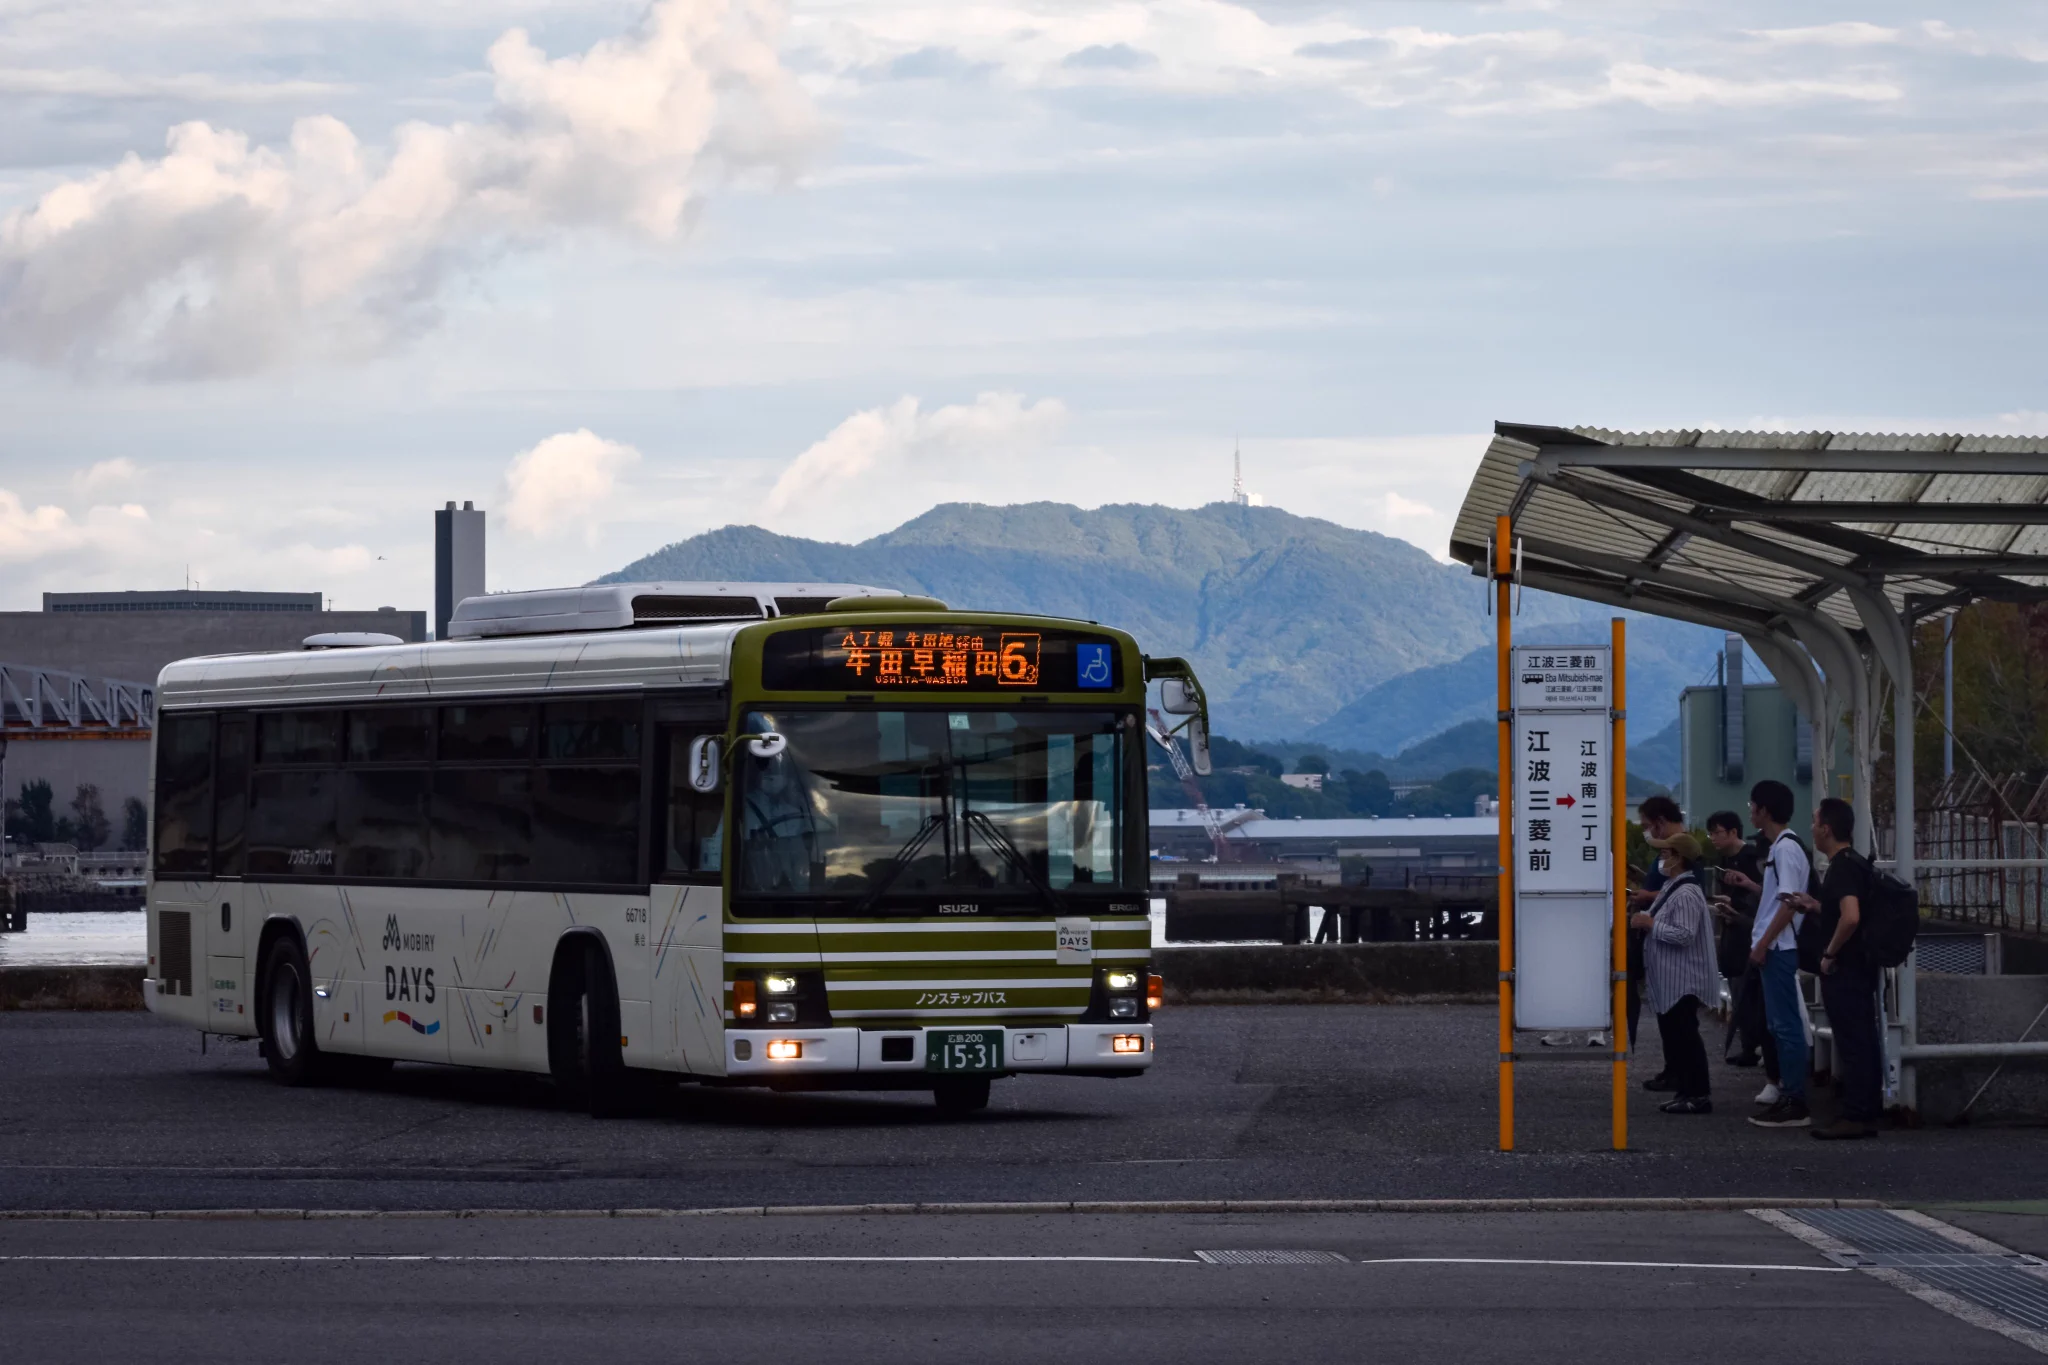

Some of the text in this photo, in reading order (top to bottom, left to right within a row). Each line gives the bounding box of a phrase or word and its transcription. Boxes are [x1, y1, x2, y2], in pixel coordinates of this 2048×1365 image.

[841, 631, 893, 647] 八丁堀
[846, 649, 997, 676] 牛田早稲田
[1002, 641, 1027, 679] 6
[1528, 656, 1596, 668] 江波三菱前
[875, 675, 968, 684] USHITA-WASEDA
[1545, 673, 1603, 682] Eba Mitsubishi-mae
[1527, 730, 1551, 871] 江波三菱前
[1580, 740, 1598, 862] 江波南二丁目
[287, 848, 333, 865] ノンステップバス
[625, 907, 647, 923] 66718
[938, 904, 979, 913] ISUZU
[1108, 903, 1140, 912] ERGA
[403, 933, 435, 952] MOBIRY
[1060, 937, 1089, 946] DAYS
[385, 965, 436, 1004] DAYS
[916, 991, 1006, 1005] ノンステップバス
[944, 1043, 997, 1069] 15-31
